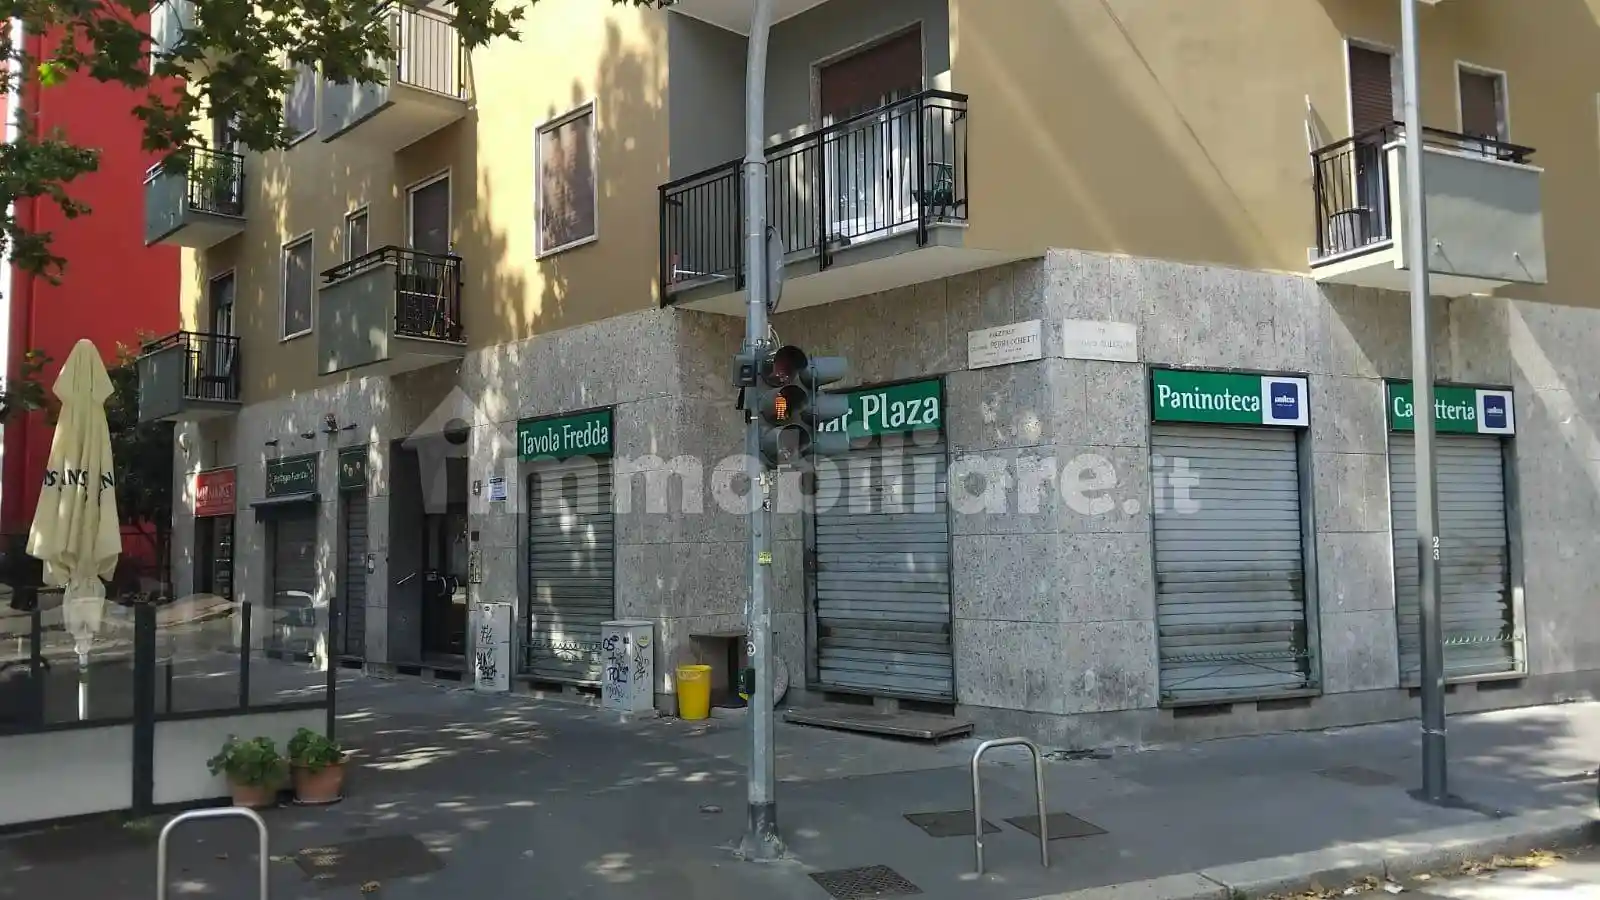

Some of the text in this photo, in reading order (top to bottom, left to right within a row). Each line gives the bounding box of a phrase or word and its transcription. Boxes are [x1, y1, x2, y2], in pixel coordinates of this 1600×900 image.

[860, 392, 939, 431] Plaza
[1157, 384, 1260, 412] Paninoteca
[1394, 396, 1475, 420] Catteria
[520, 420, 609, 455] Tavola Fredda
